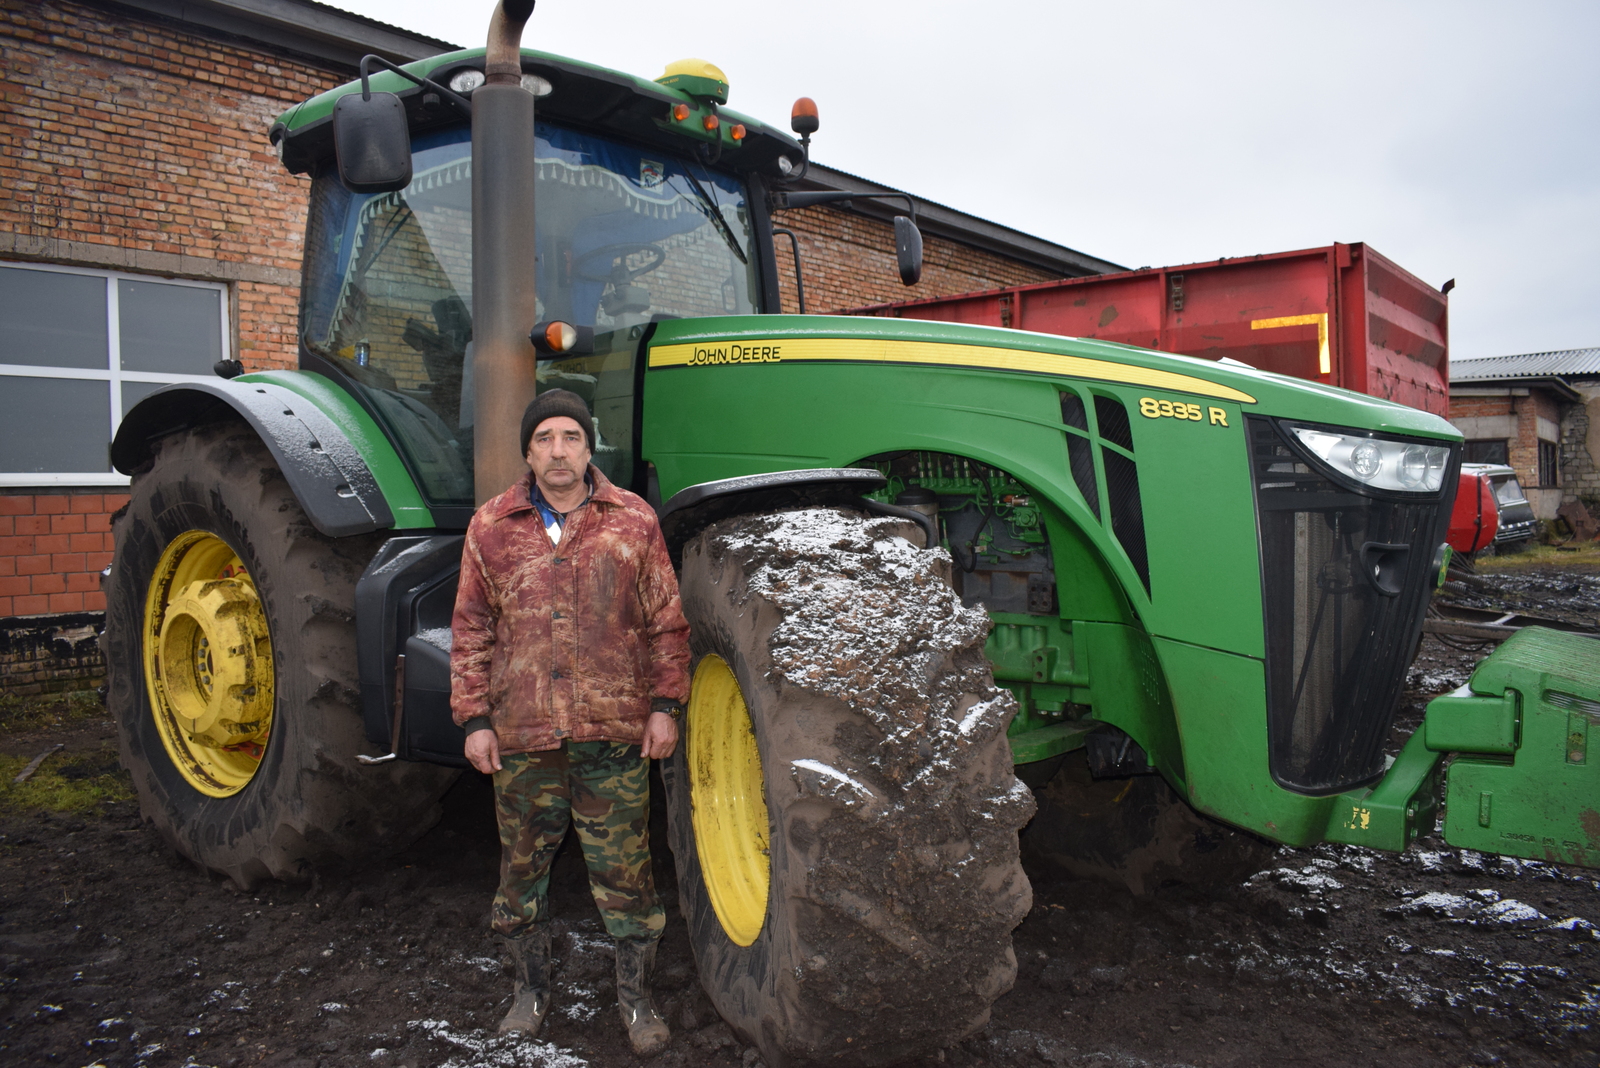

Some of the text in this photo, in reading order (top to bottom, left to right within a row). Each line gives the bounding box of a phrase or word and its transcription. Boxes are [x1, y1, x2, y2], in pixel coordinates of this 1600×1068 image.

[730, 344, 781, 361] DEERE
[1139, 397, 1229, 427] 8335 R
